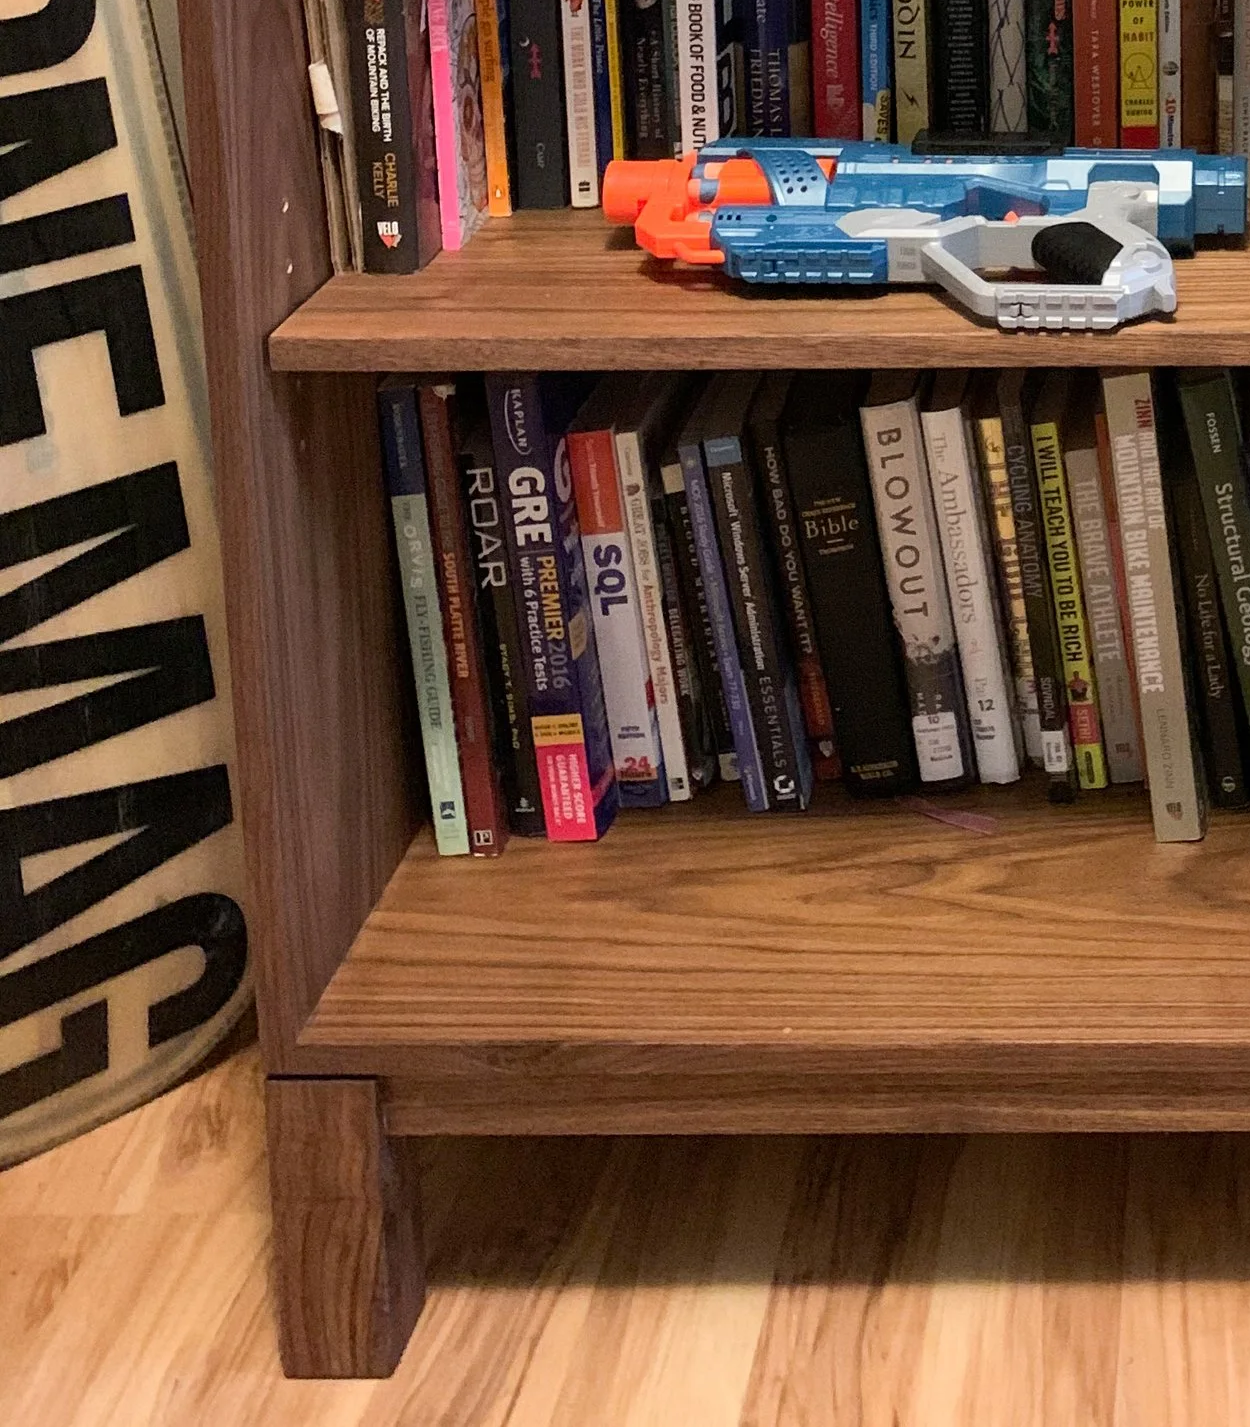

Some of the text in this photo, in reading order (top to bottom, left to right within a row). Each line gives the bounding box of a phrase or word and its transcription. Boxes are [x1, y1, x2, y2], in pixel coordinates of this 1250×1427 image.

[688, 2, 704, 42] BOOK
[1121, 0, 1154, 10] POWER
[1131, 16, 1145, 27] OF
[482, 39, 500, 84] surfing
[690, 43, 705, 63] OF
[1090, 29, 1101, 59] TARA
[1122, 31, 1154, 43] HABIT
[365, 28, 382, 133] OF MOUNTAIN BIKING
[375, 27, 393, 142] REPACK AND THE BIRTH
[691, 64, 706, 103] FOOD
[766, 47, 783, 124] THOMAS
[869, 52, 880, 92] EDITION
[1091, 64, 1103, 127] WESTOVER
[1165, 97, 1178, 114] 10
[371, 161, 385, 200] KELLY
[384, 152, 400, 208] CHARLIE
[511, 387, 530, 449] KAPLAN
[1203, 412, 1223, 455] FOSSEN
[1006, 444, 1034, 513] CYCLING
[1038, 444, 1060, 486] WILL
[1134, 398, 1166, 531] ZINN AND THE ART OF
[507, 466, 554, 547] GRE
[876, 426, 930, 618] BLOWOUT
[1044, 486, 1067, 537] TEACH
[1073, 477, 1100, 520] THE
[465, 466, 507, 590] ROAR
[763, 445, 814, 654] HOW BAD DO YOU WANT IT?
[803, 514, 860, 540] Bible
[932, 432, 980, 624] The Ambassadors
[1079, 519, 1110, 579] BRAVE
[1214, 482, 1250, 582] Structural
[592, 544, 628, 617] SQL
[1013, 517, 1044, 598] ANATOMY
[1051, 540, 1072, 573] YOU
[1114, 433, 1166, 694] MOUNTAIN BIKE MAINTENANCE
[535, 554, 566, 641] PREMIER
[1056, 576, 1075, 596] TO
[1058, 599, 1079, 620] BE
[1194, 572, 1211, 598] No
[402, 523, 443, 730] ORVIS FLY-FISHING GUIDE
[442, 551, 458, 595] SOUTH
[453, 642, 470, 679] RIVER
[519, 555, 549, 692] with 6 Practice Tests
[643, 584, 666, 663] Anthropology
[720, 471, 788, 769] Microsoft Windows Server Administration ESSENTIALS
[1087, 583, 1122, 663] ATHLETE
[1196, 599, 1218, 630] Life
[547, 640, 573, 690] 2016
[1062, 624, 1084, 663] RICH
[1202, 629, 1218, 651] for
[654, 666, 672, 706] Majors
[977, 698, 996, 713] 12
[1039, 675, 1057, 721] SOVNDAL
[1207, 664, 1225, 699] Lady
[1076, 707, 1092, 740] SETHI
[554, 753, 574, 821] GUARANTEED
[624, 755, 651, 772] 24
[568, 753, 587, 825] HIGHER SCORE
